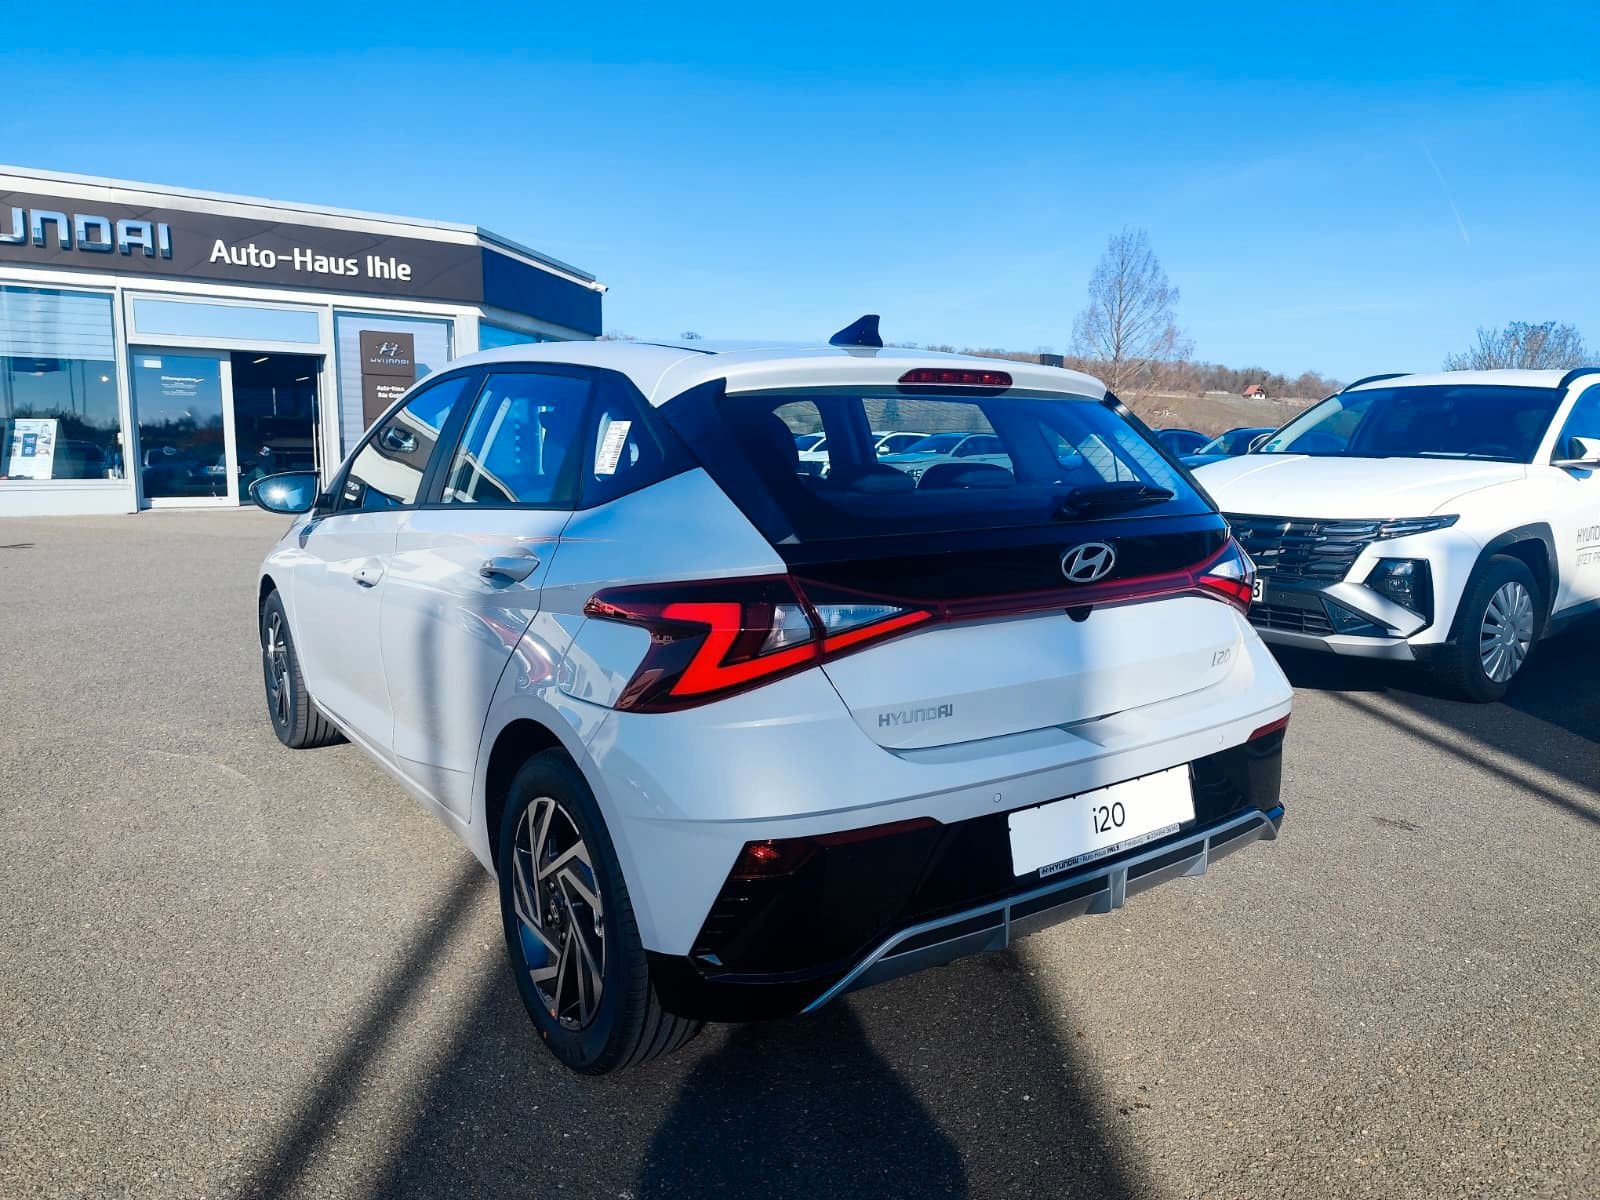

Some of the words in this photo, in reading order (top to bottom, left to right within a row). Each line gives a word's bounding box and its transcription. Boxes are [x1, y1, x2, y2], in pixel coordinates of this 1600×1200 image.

[209, 239, 359, 276] Auto-Haus
[366, 255, 412, 281] Ihle
[878, 703, 953, 727] HYUNDAI
[1093, 802, 1126, 834] i20
